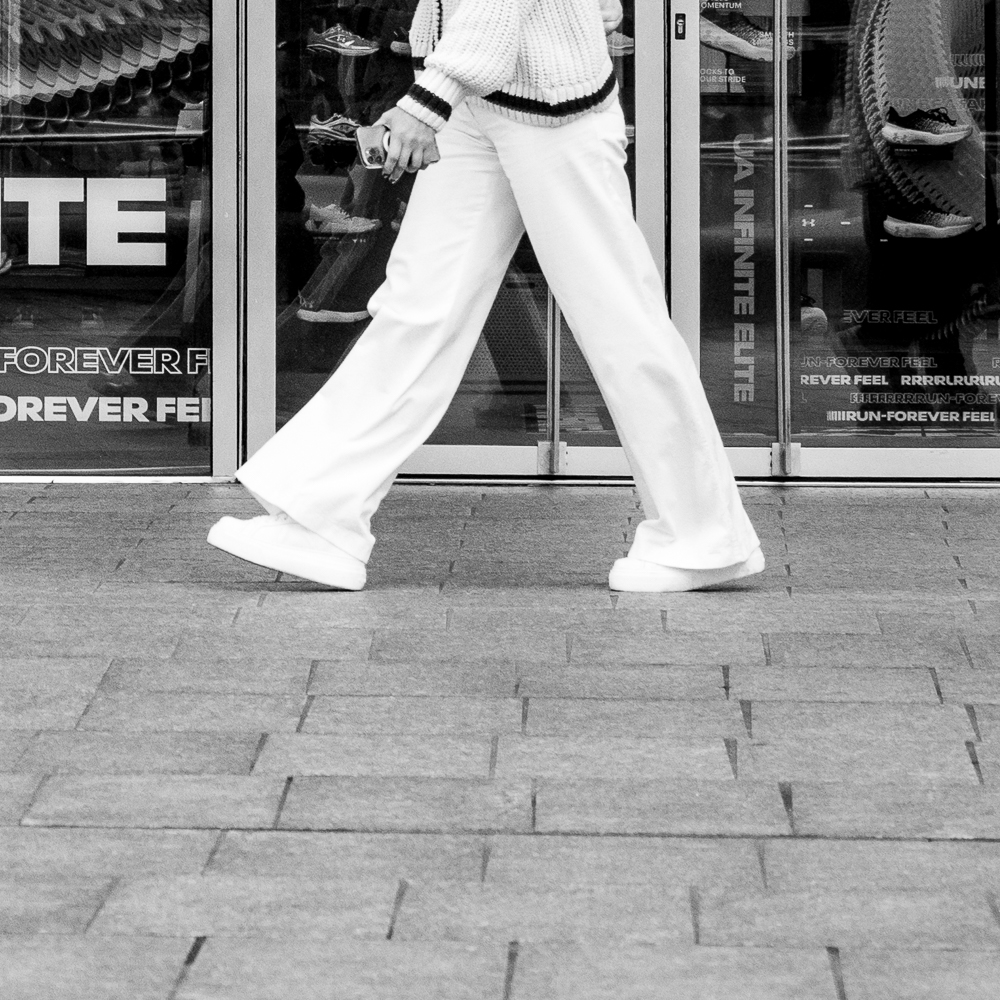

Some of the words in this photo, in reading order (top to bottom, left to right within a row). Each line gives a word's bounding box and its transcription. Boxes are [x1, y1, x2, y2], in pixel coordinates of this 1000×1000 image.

[733, 189, 755, 316] INFINITE
[893, 310, 938, 324] FEEL
[733, 322, 755, 402] ELITE
[901, 356, 938, 369] FEEL
[853, 374, 890, 386] FEEL
[962, 411, 996, 422] FEEL
